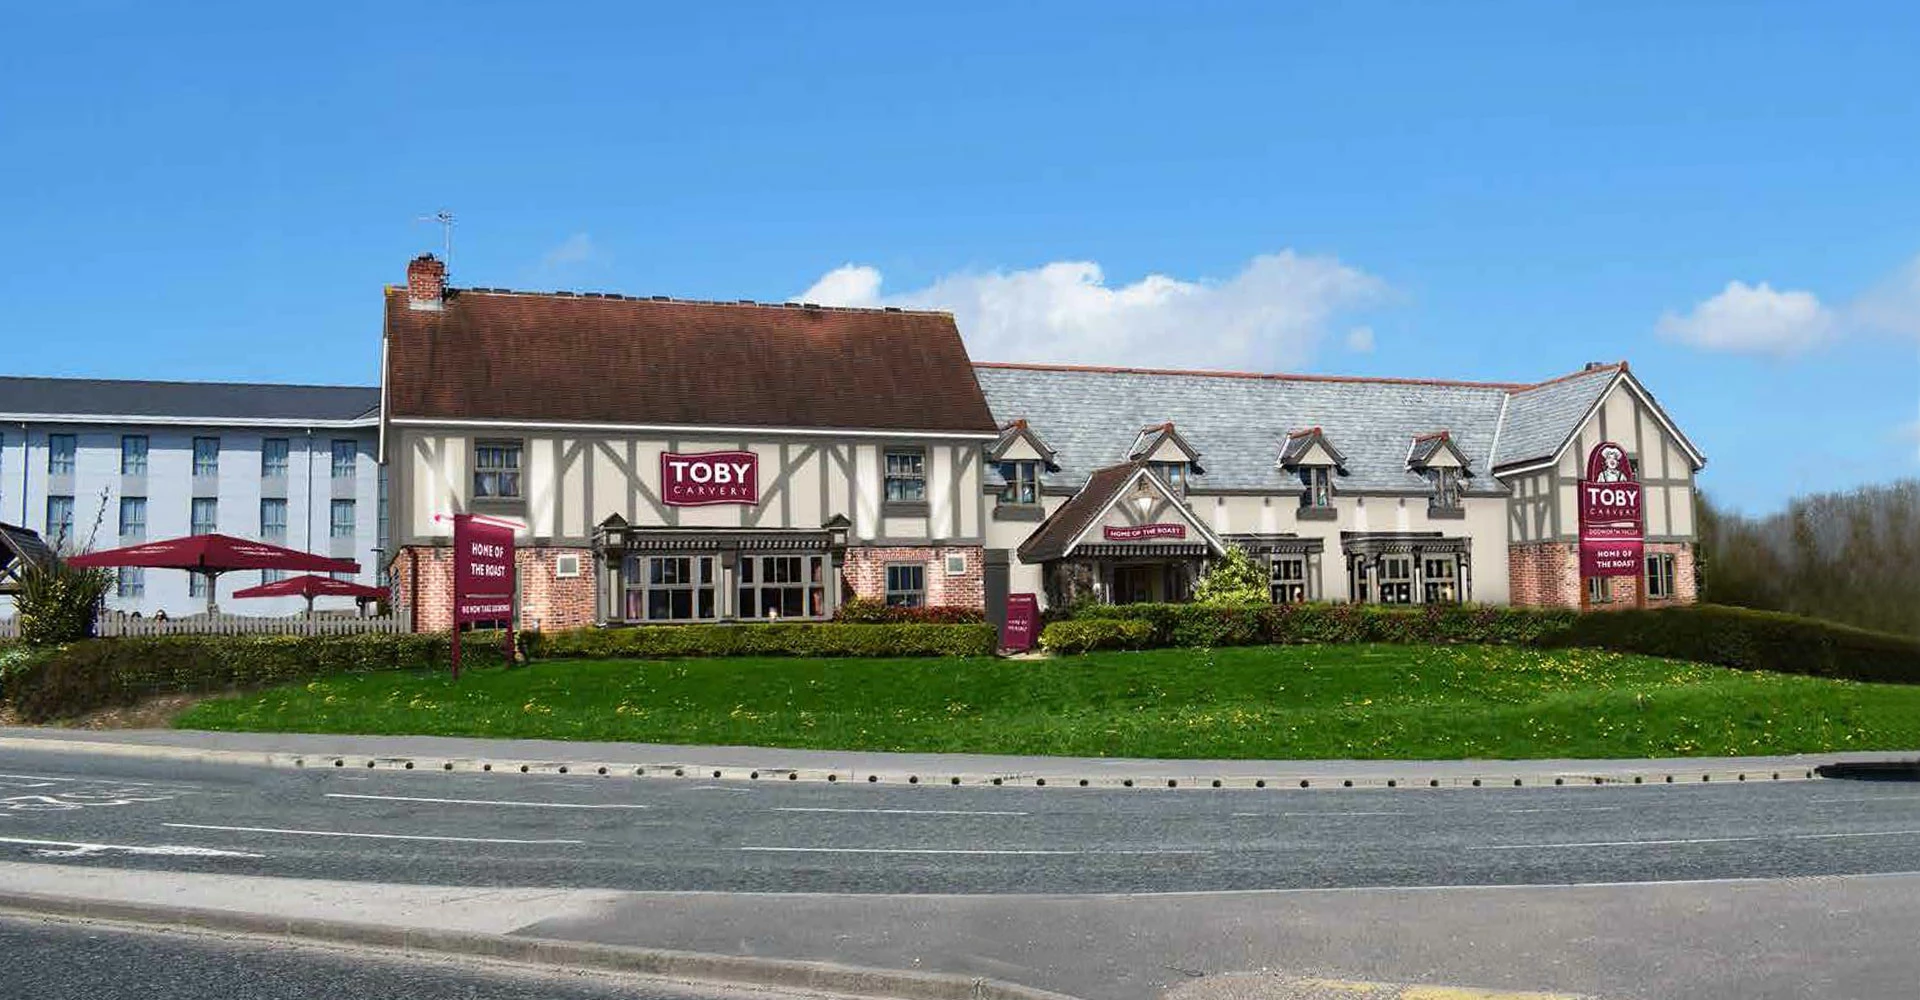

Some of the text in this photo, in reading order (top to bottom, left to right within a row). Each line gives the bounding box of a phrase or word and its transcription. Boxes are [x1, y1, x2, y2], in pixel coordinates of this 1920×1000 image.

[669, 462, 751, 484] TOBY
[673, 486, 747, 495] CARVERY
[1587, 488, 1638, 507] TOBY
[1590, 508, 1636, 516] CARVERY
[472, 543, 504, 558] HOME OF
[471, 562, 505, 577] THE ROAST
[1612, 560, 1635, 568] ROAST
